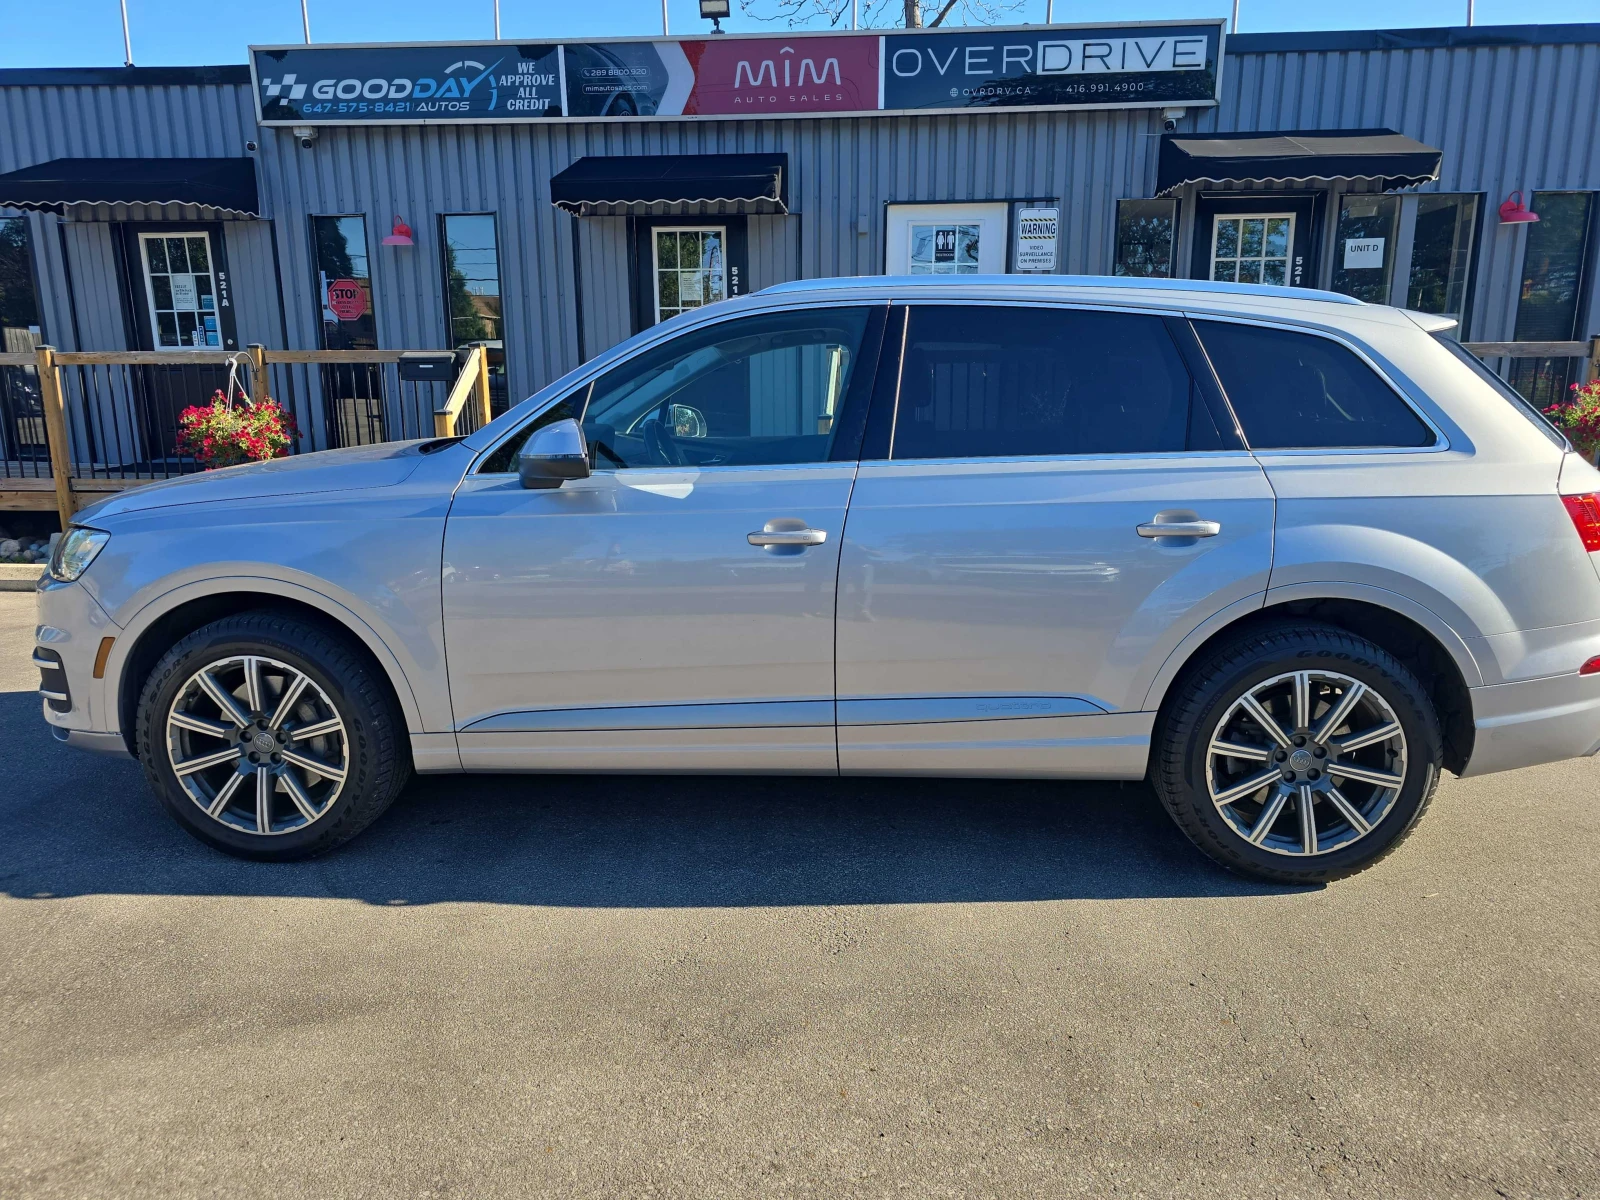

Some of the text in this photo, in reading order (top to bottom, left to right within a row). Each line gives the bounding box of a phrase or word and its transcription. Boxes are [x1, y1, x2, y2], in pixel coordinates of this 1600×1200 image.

[893, 38, 1204, 77] OVERDRIVE
[517, 62, 535, 73] WE
[590, 69, 607, 77] 289
[499, 74, 555, 86] APPROVE
[517, 86, 538, 98] ALL
[585, 84, 648, 92] mimautosales.com
[962, 86, 1031, 97] OVRDRV.CA
[1066, 82, 1144, 94] 416.991.4900
[507, 98, 551, 110] CREDIT
[734, 94, 842, 104] AUTO SALES
[302, 102, 410, 113] 647-575-8421
[416, 101, 470, 112] AUTOS
[1020, 222, 1056, 235] WARNING
[1350, 244, 1379, 252] UNIT D
[332, 289, 359, 299] STOP
[1296, 649, 1426, 722] GOODYEAR
[975, 701, 1053, 713] quattro
[143, 649, 194, 784] EAGLE SPORT
